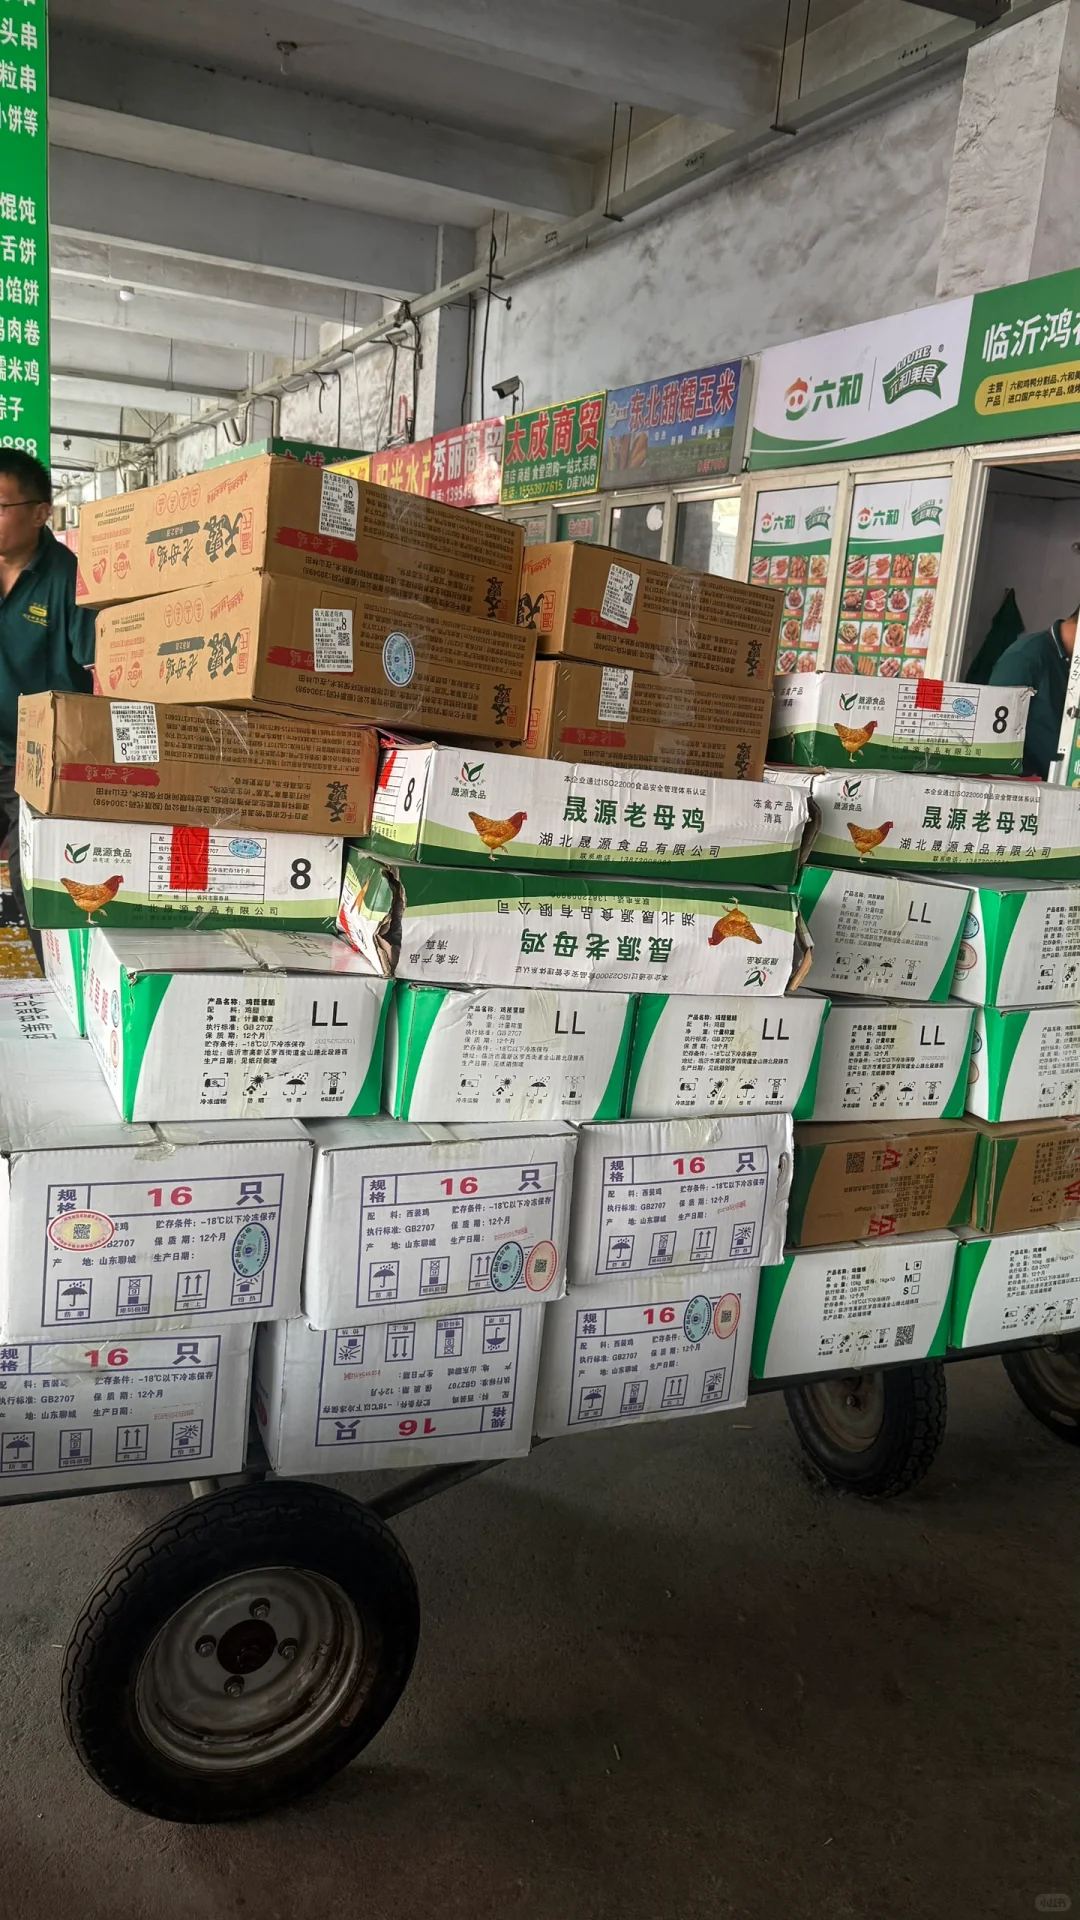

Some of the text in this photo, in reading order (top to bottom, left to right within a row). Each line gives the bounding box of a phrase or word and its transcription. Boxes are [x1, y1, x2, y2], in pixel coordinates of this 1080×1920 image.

[0, 275, 39, 306] 馅饼
[812, 373, 864, 412] 六和
[988, 381, 1004, 394] 主营
[628, 368, 735, 431] 东北甜糯玉米
[985, 395, 1000, 407] 产品
[506, 399, 602, 465] 太成商贸
[348, 485, 354, 499] 8
[773, 514, 796, 530] 六和
[872, 509, 899, 526] 六和
[628, 579, 634, 591] 8
[342, 618, 347, 631] 8
[623, 674, 629, 686] 8
[992, 706, 1009, 734] 8
[121, 743, 127, 755] 8
[85, 765, 135, 783] 老母鸡
[403, 778, 415, 811] 8
[450, 787, 487, 800] 晟源食品
[563, 775, 707, 797] 本企业通过ISO22000食品安全管理体系认证
[324, 781, 349, 822] 天露
[753, 799, 794, 812] 冻禽产品
[833, 802, 862, 812] 晟源食品
[562, 796, 705, 833] 晟源老母鸡
[763, 813, 782, 825] 清真
[921, 806, 1039, 836] 晟源老母鸡
[92, 847, 132, 858] 晟源食品
[538, 832, 720, 858] 湖北晟源食品有限公司
[899, 838, 1052, 858] 湖北晟源食品有限公司
[290, 857, 312, 890] 8
[131, 904, 279, 916] 湖北晟源食品有限公司
[497, 900, 696, 926] 湖北晟源食品有限公司
[908, 901, 931, 923] LL
[425, 939, 449, 950] 清真
[520, 928, 674, 963] 晟源老母鸡
[410, 953, 459, 964] 冻禽产品
[747, 956, 779, 966] 晟源食品
[515, 965, 669, 981] 本企业通过ISO22000食品安全管理体系认证
[311, 1001, 348, 1027] LL
[555, 1011, 585, 1034] LL
[761, 1018, 789, 1040] LL
[920, 1025, 945, 1045] LL
[610, 1161, 624, 1182] 规格
[673, 1157, 706, 1175] 16
[736, 1152, 756, 1173] 只
[440, 1176, 479, 1196] 16
[518, 1168, 542, 1191] 只
[57, 1188, 78, 1213] 规格
[148, 1186, 193, 1207] 16
[236, 1181, 264, 1206] 只
[369, 1180, 386, 1203] 规格
[607, 1202, 666, 1212] 执行标准：GB2707
[156, 1210, 277, 1230] 贮存条件：-18℃以下冷冻保存
[451, 1216, 511, 1229] 保质期：12个月
[366, 1224, 435, 1237] 执行标准：GB2707
[450, 1234, 485, 1245] 生产日期：
[154, 1233, 226, 1247] 保质期：12个月
[365, 1238, 437, 1251] 产地：山东聊城
[52, 1253, 137, 1268] 产地：山东聊城
[153, 1251, 195, 1263] 生产日期：
[905, 1263, 910, 1271] L
[904, 1274, 912, 1283] M
[903, 1287, 909, 1295] S
[582, 1313, 598, 1334] 规格
[643, 1307, 675, 1325] 16
[0, 1348, 19, 1372] 规格
[84, 1348, 129, 1368] 16
[172, 1342, 201, 1365] 只
[448, 1376, 510, 1390] 执行标准：GB2707
[93, 1390, 164, 1402] 保质期：12个月
[92, 1406, 133, 1417] 生产日期：
[491, 1407, 506, 1428] 规格
[334, 1420, 361, 1441] 只
[399, 1418, 436, 1436] 16
